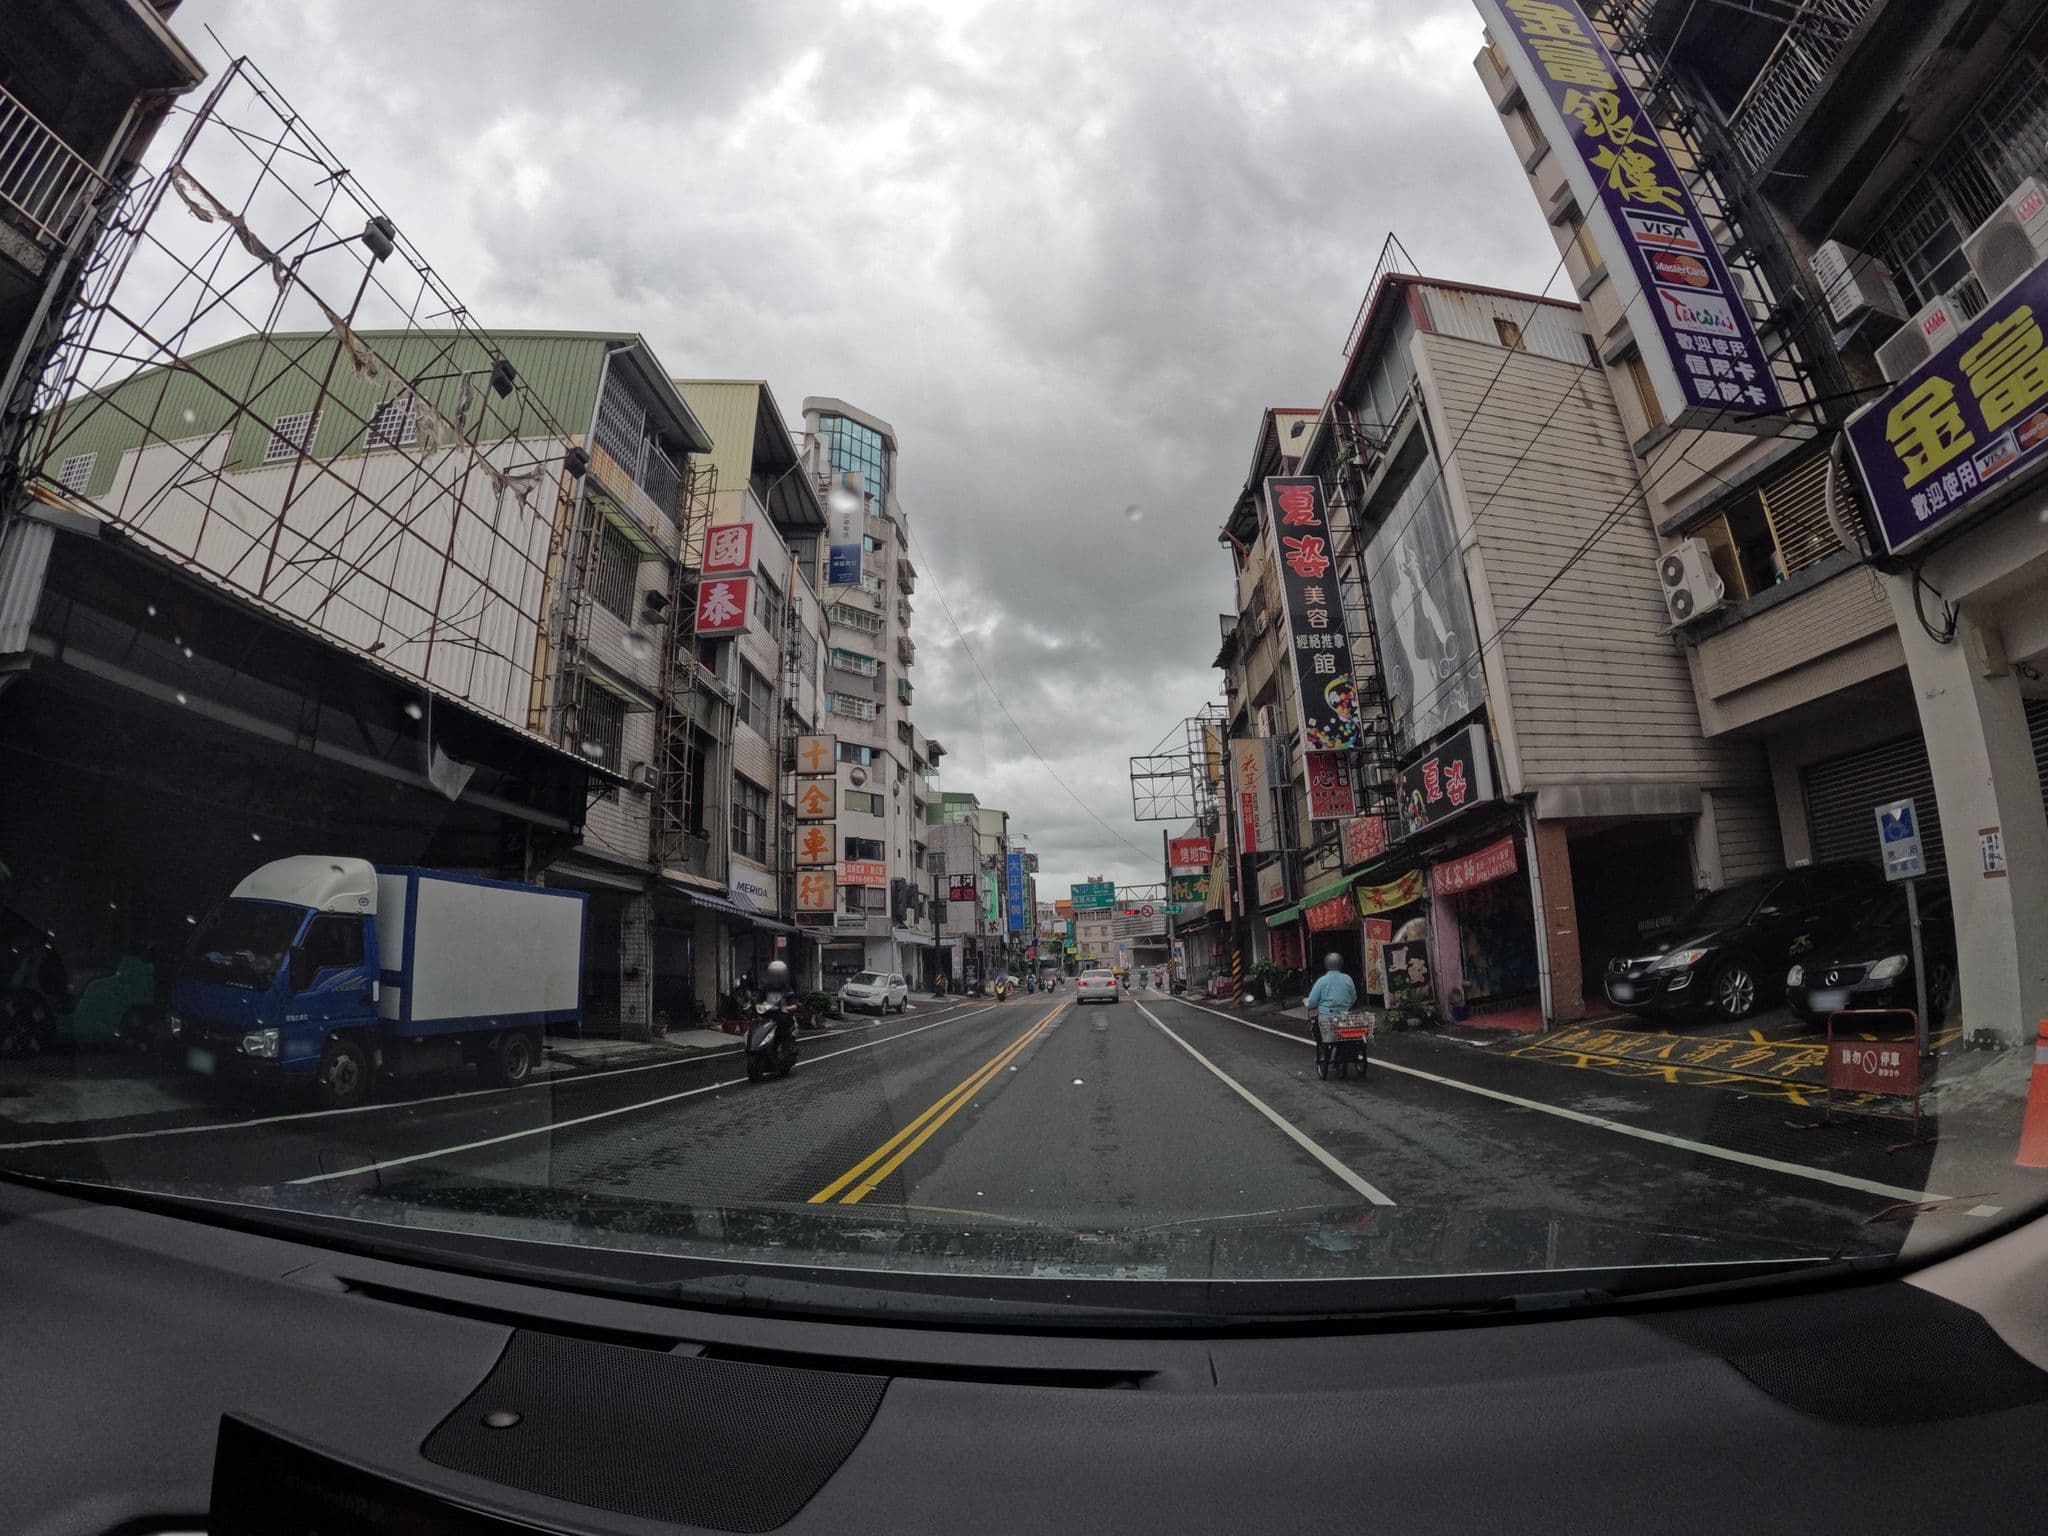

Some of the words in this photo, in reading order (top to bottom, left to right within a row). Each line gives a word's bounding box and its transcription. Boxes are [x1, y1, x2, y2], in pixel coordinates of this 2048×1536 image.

[1643, 221, 1686, 239] VISA
[1655, 261, 1707, 278] MasterCard
[1675, 332, 1749, 359] 歡迎使用
[1685, 354, 1757, 382] 信用卡
[1911, 460, 1978, 522] 歡迎使用
[1274, 485, 1331, 579] 夏姿
[700, 526, 748, 627] 國泰
[1313, 652, 1337, 675] 館
[1422, 757, 1467, 806] 夏姿
[800, 739, 832, 908] 十全車行
[736, 880, 769, 899] MERIDA
